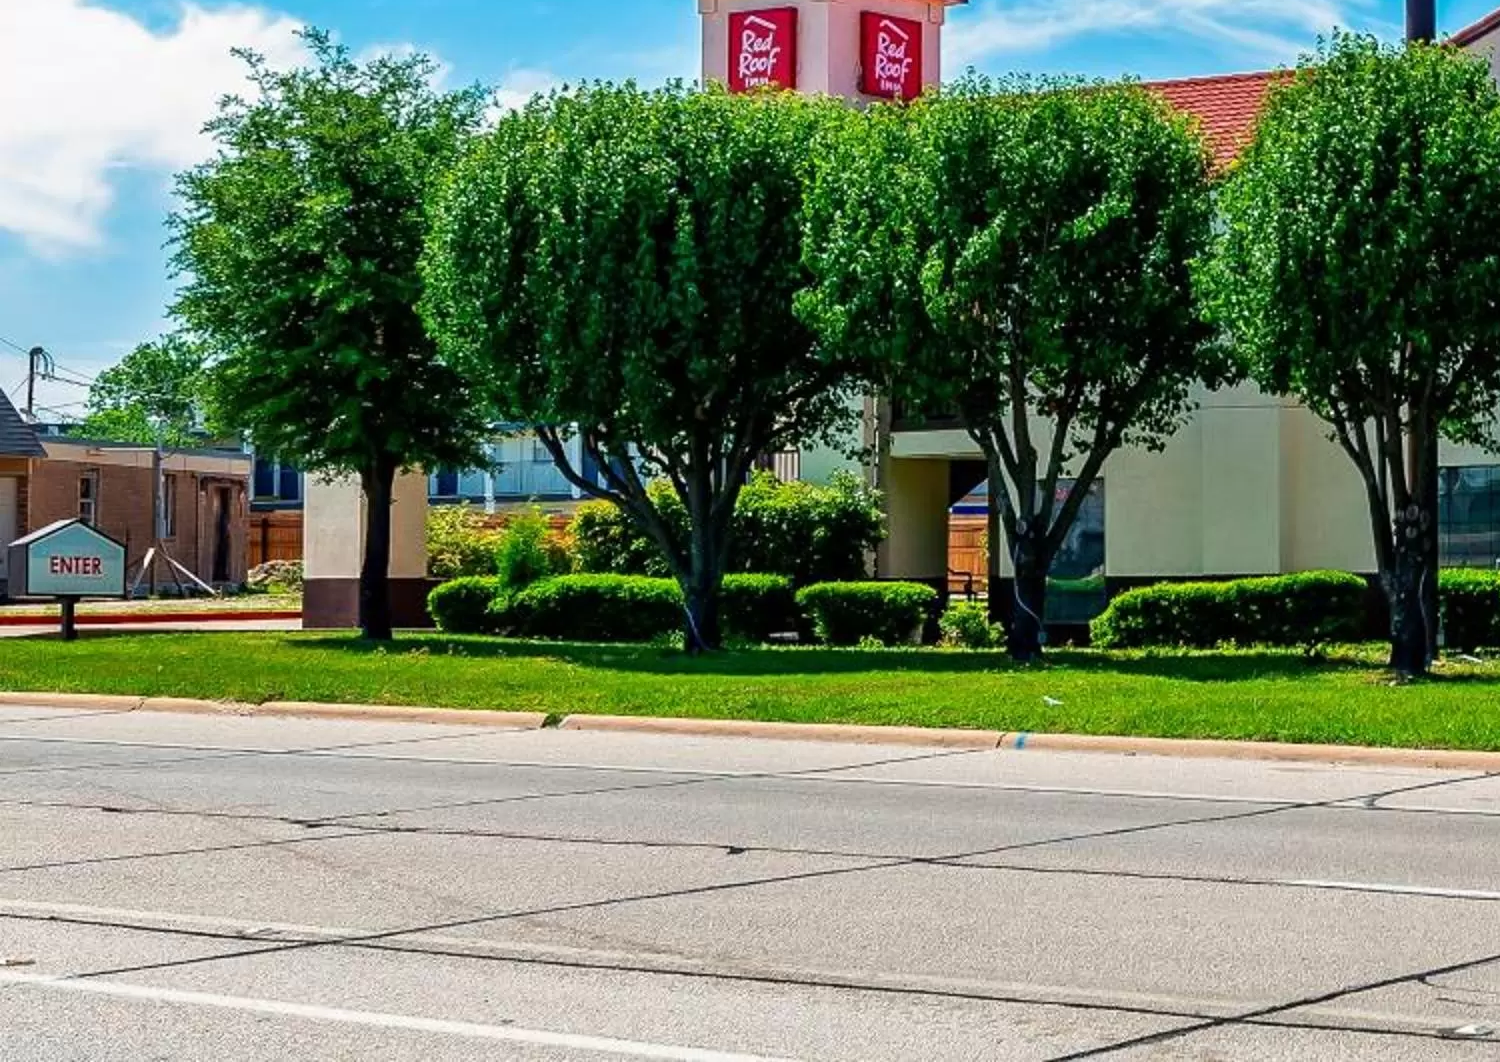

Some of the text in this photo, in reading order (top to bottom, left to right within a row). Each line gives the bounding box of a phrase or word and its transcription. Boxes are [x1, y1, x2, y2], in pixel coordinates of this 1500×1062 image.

[742, 29, 774, 53] Red
[877, 32, 906, 58] Red
[738, 46, 781, 79] Roof
[875, 53, 912, 85] Roof
[50, 555, 103, 575] ENTER
